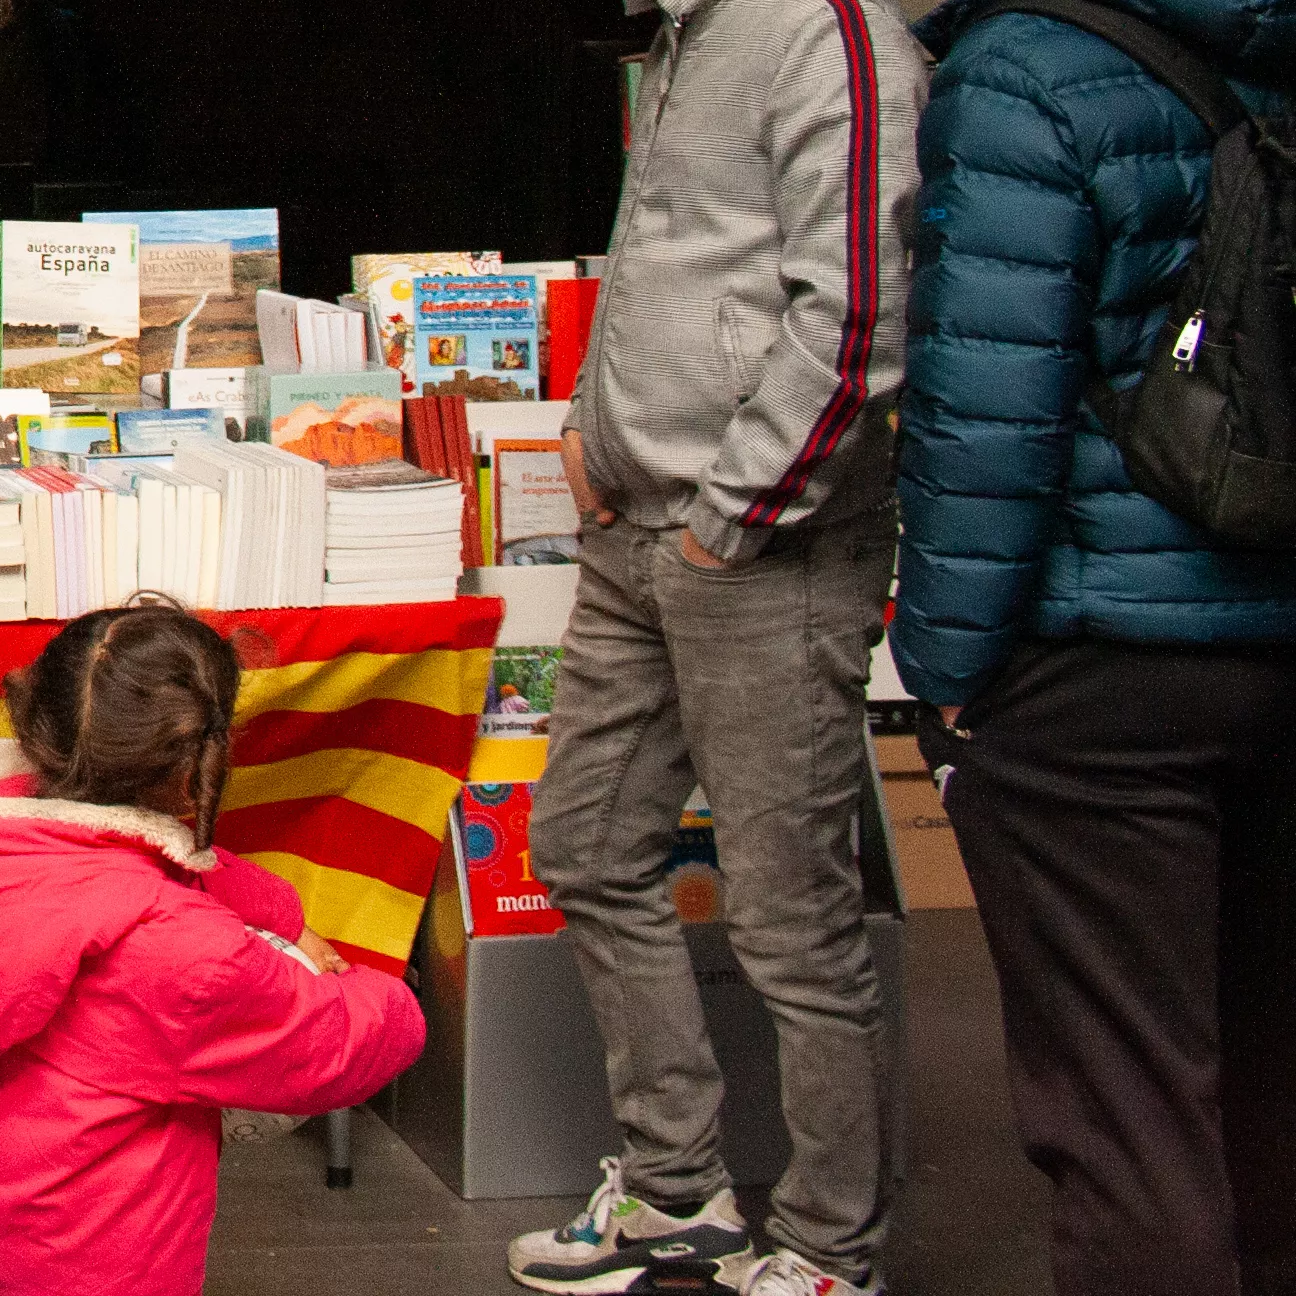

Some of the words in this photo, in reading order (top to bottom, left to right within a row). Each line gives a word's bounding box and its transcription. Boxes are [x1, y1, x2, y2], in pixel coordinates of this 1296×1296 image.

[26, 243, 117, 254] autocaravana
[164, 249, 218, 261] CAMINO
[40, 254, 110, 277] España
[491, 720, 535, 733] jardines
